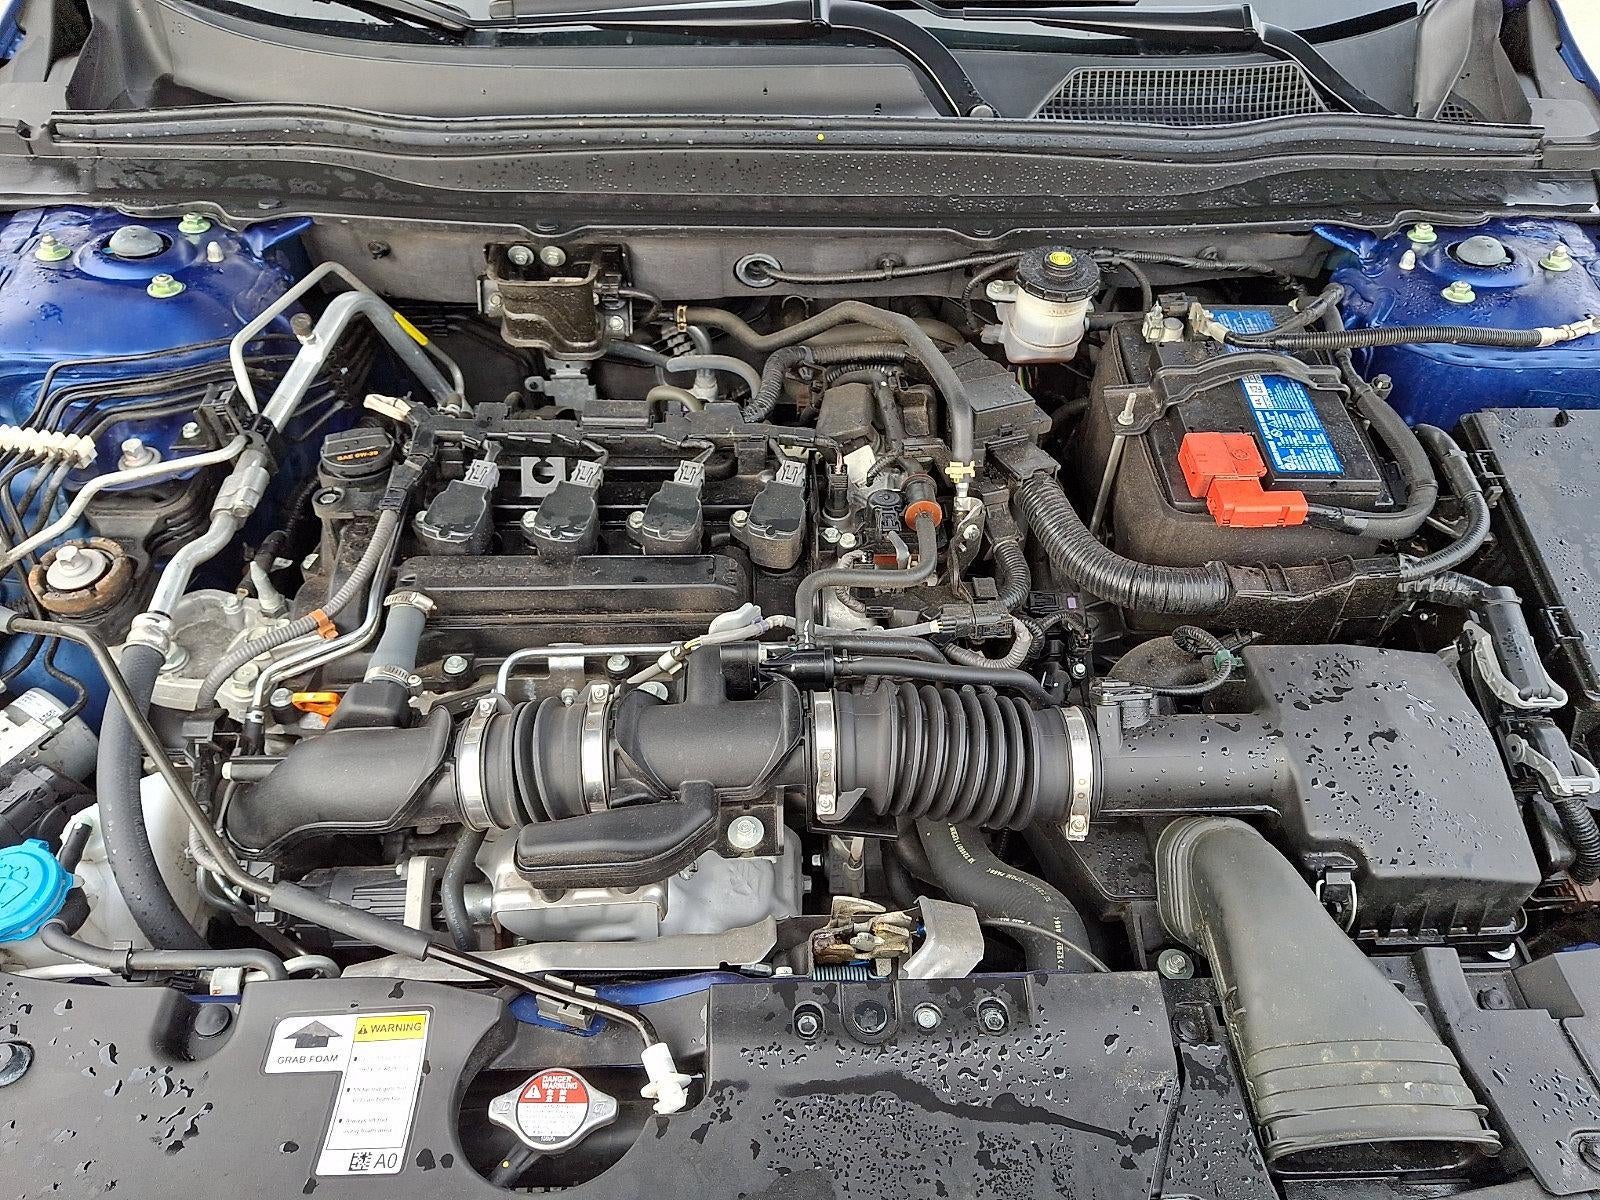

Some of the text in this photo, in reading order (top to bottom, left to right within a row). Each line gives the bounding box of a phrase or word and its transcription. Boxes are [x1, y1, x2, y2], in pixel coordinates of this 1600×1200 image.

[336, 453, 354, 461] SAE
[371, 1022, 422, 1033] WARNING
[277, 1054, 339, 1064] GRAB FOAM
[542, 1082, 578, 1090] WARNING
[373, 1152, 398, 1169] A0
